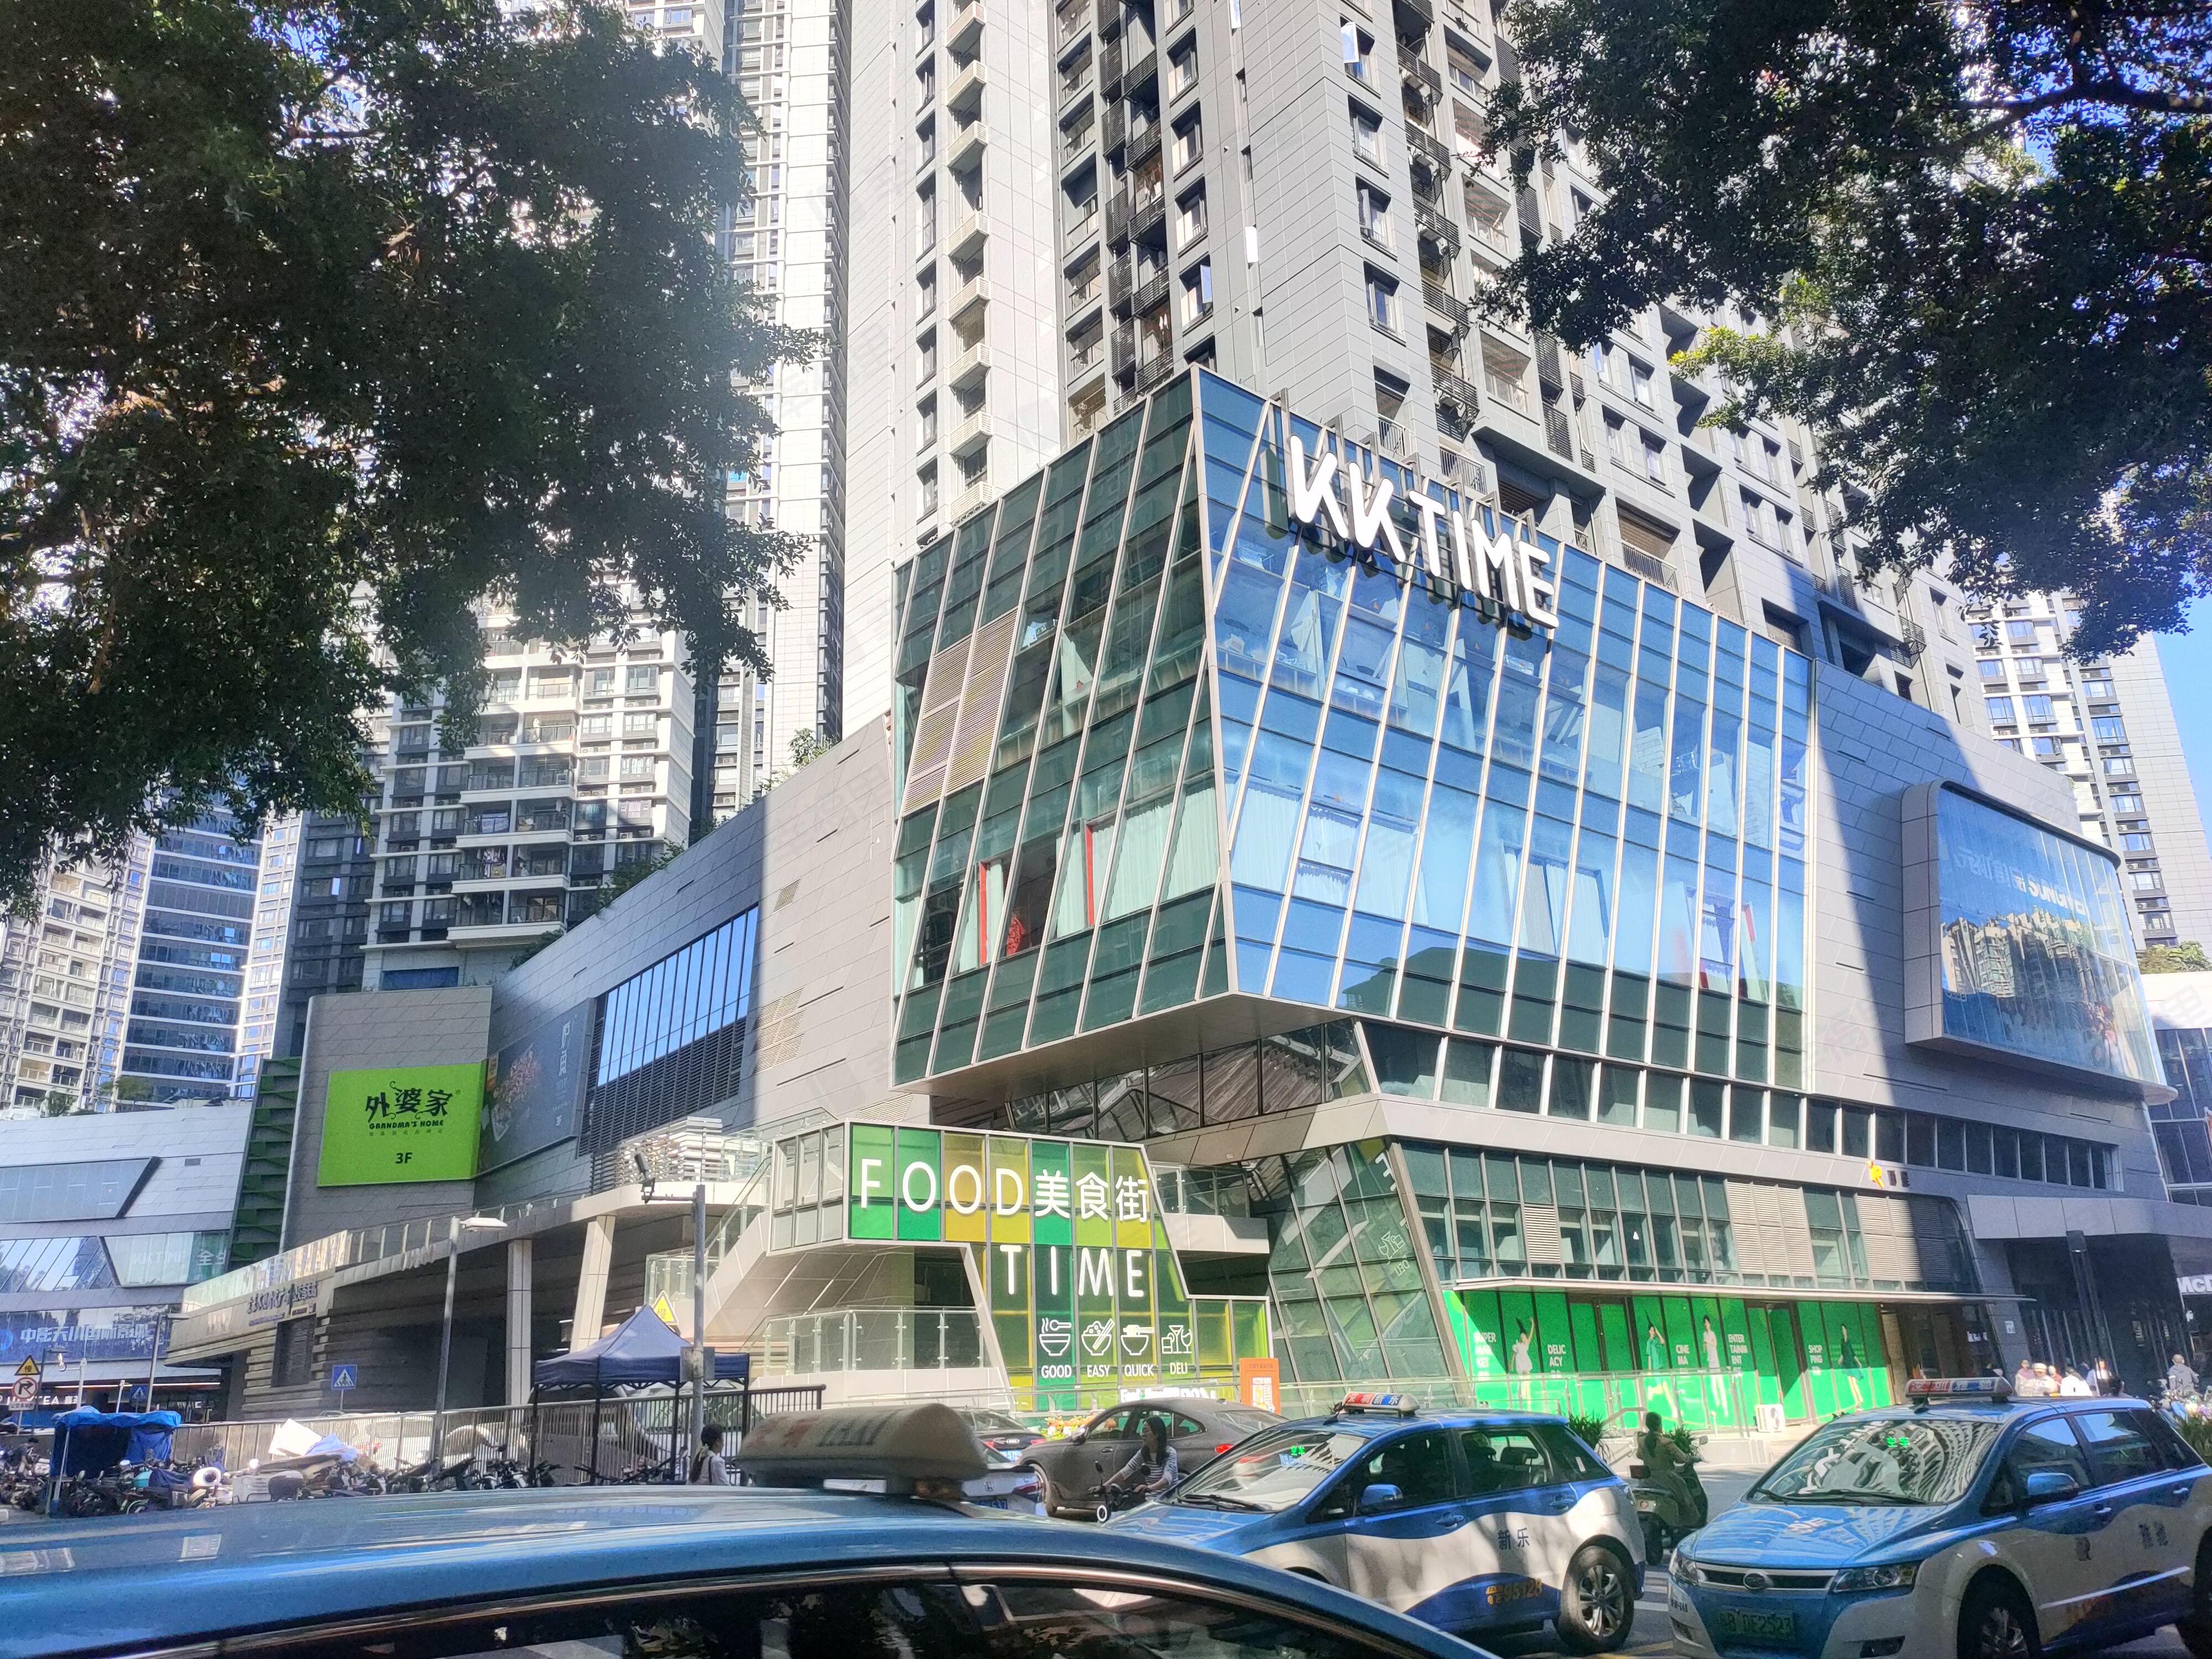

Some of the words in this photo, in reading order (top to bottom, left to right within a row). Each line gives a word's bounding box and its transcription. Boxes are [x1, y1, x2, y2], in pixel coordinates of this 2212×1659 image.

[365, 1081, 453, 1123] 外婆家
[395, 1152, 413, 1164] 3F
[860, 1158, 1024, 1215] FOOD
[1035, 1168, 1149, 1223] 美食街
[1000, 1245, 1144, 1297] TIME
[1728, 1334, 1745, 1343] ENTER
[1547, 1344, 1566, 1355] DELIC
[1676, 1344, 1690, 1354] CINE
[1808, 1344, 1823, 1354] SHOP
[1550, 1357, 1563, 1367] ACY
[1677, 1356, 1689, 1365] MA
[1731, 1356, 1742, 1365] ENT
[1810, 1355, 1823, 1364] PING
[1041, 1365, 1072, 1378] GOOD
[1087, 1365, 1110, 1378] EASY
[1124, 1363, 1154, 1377] QUICK
[1170, 1362, 1188, 1375] DELI
[1498, 1527, 1530, 1550] 新乐
